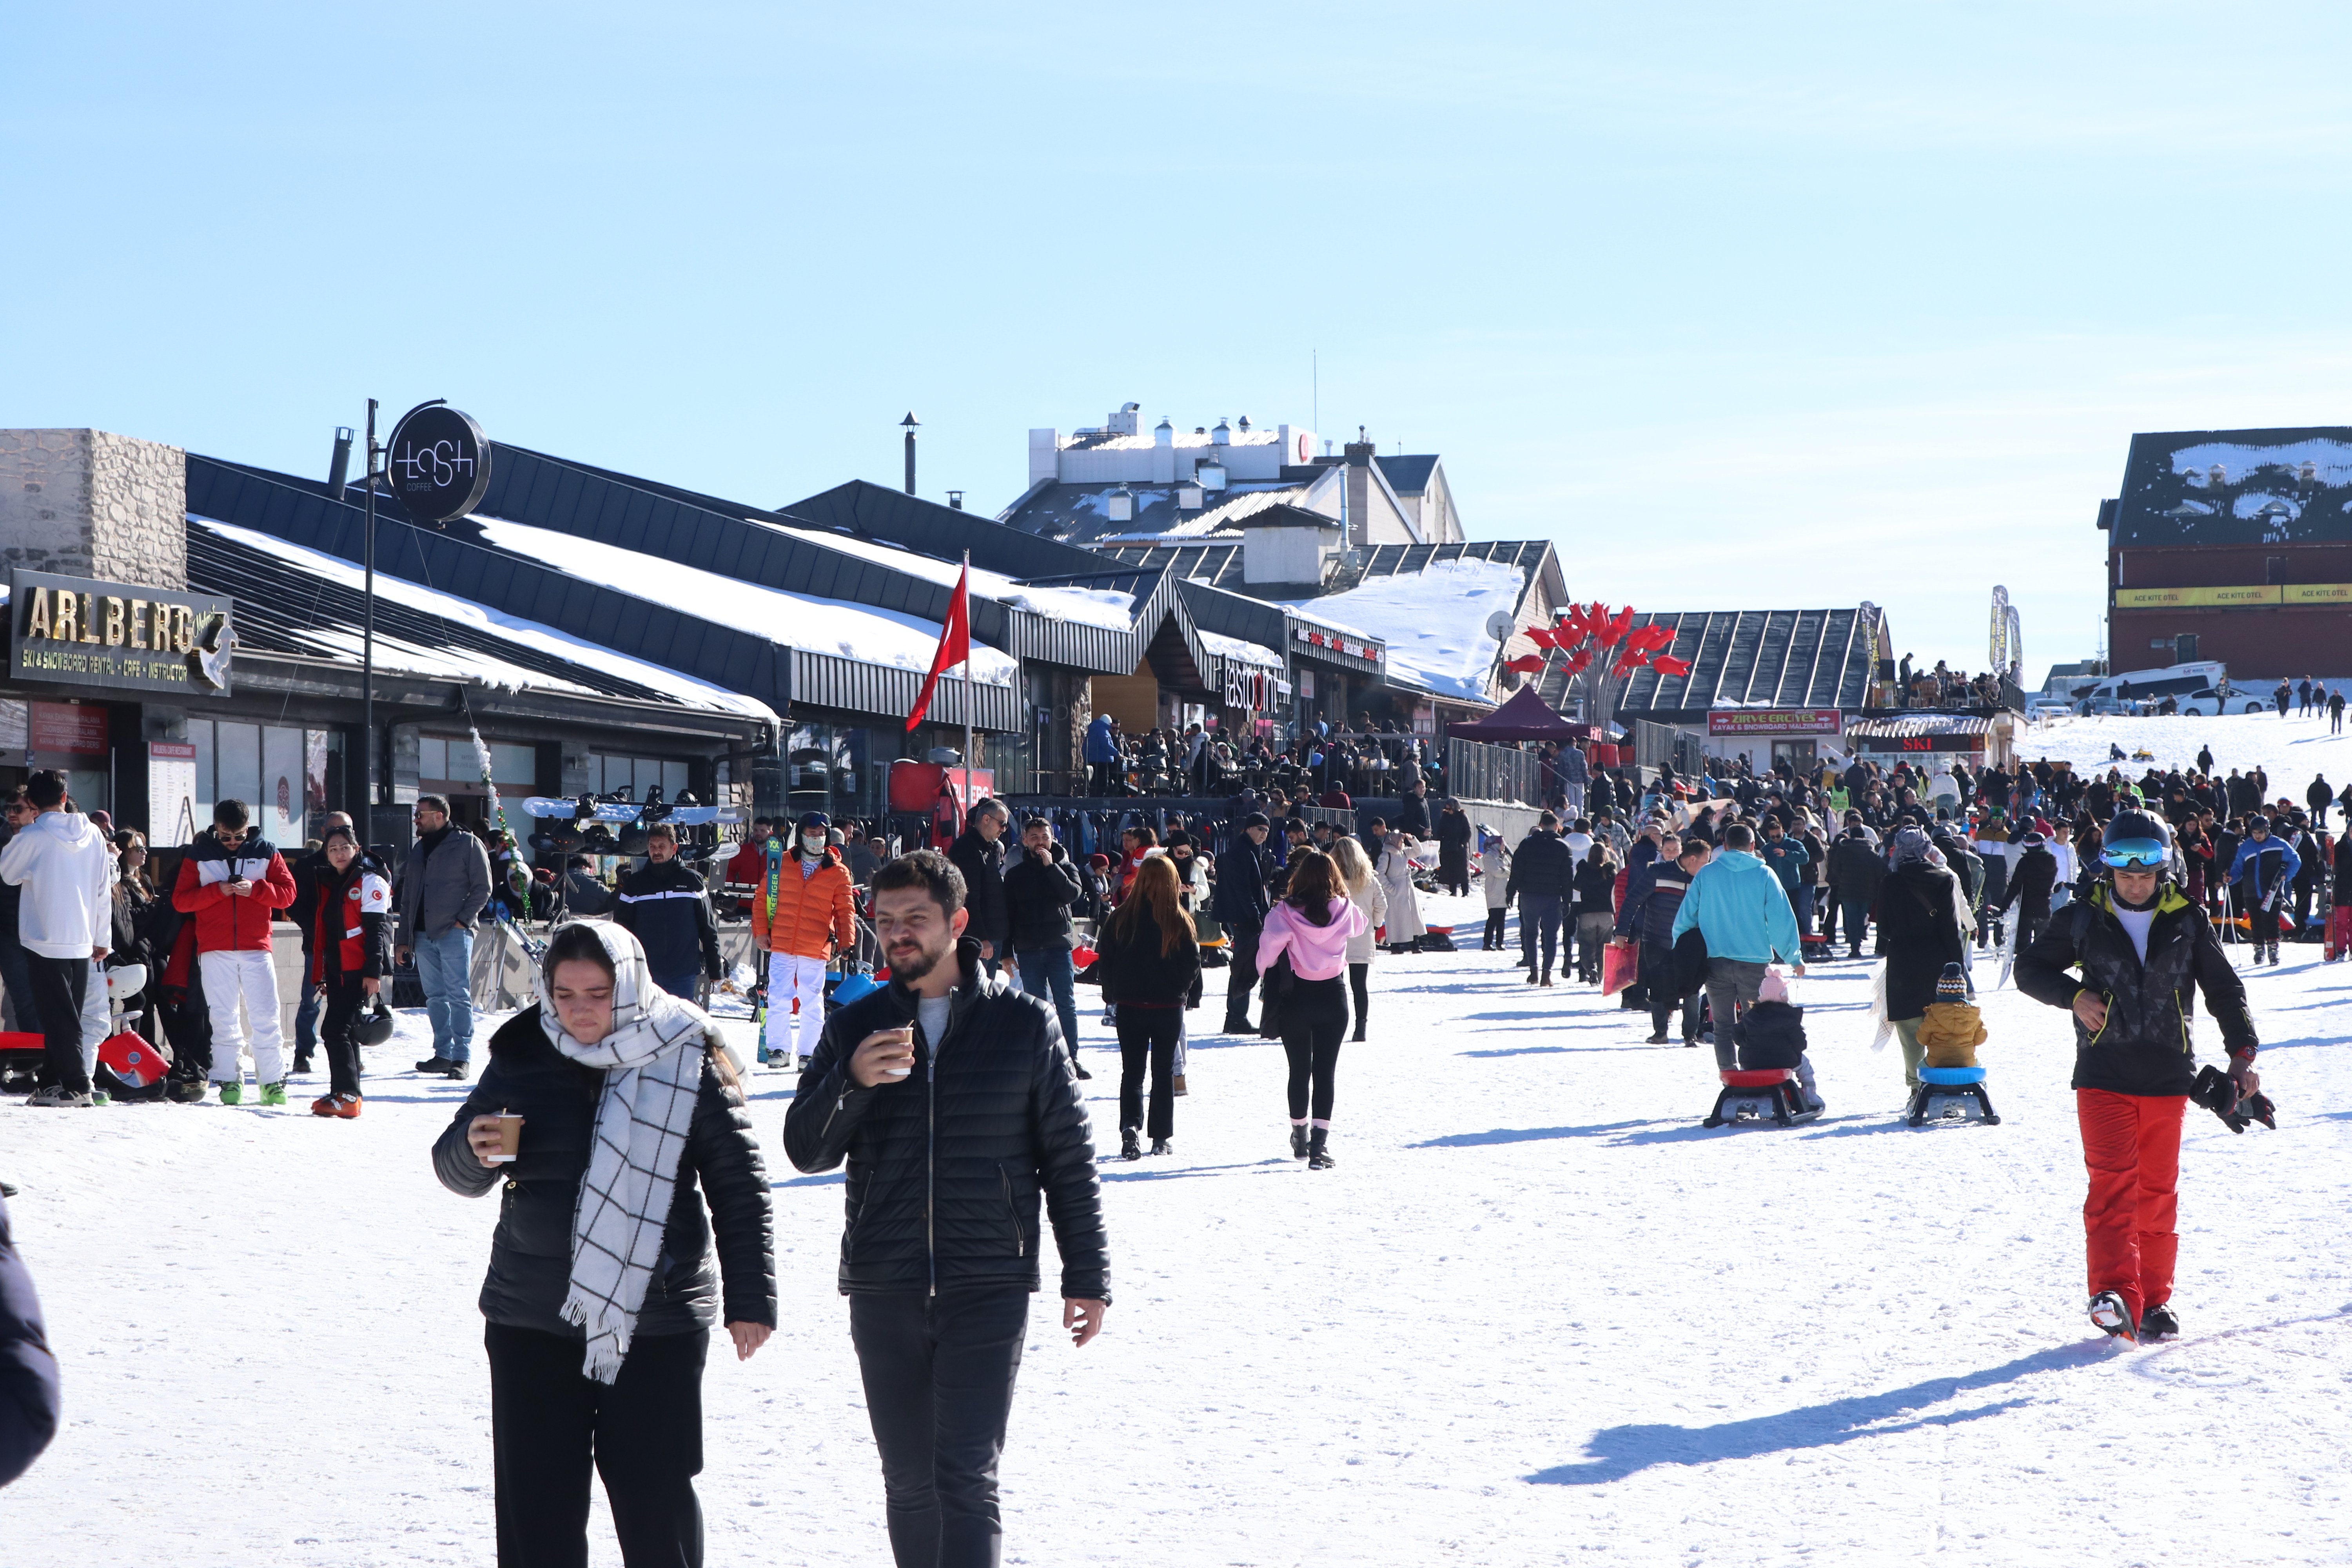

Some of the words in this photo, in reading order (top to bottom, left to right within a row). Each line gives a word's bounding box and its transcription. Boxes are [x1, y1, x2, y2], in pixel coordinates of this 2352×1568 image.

[407, 483, 432, 492] COFFEE
[28, 586, 193, 654] ARLBERG
[1298, 628, 1309, 642] KAHVE
[22, 649, 34, 667] SKI
[36, 652, 42, 666] &
[43, 651, 87, 673] SNOWBOARD
[89, 655, 114, 675] RENTAL
[123, 659, 140, 677] CAFE
[148, 662, 187, 682] INSTRUCTOR
[1225, 655, 1278, 723] lastpoint
[1731, 713, 1767, 724] ZİRVE
[1768, 713, 1816, 723] ERCİYES
[1904, 737, 1932, 750] SKI
[769, 874, 779, 921] RACETIGER
